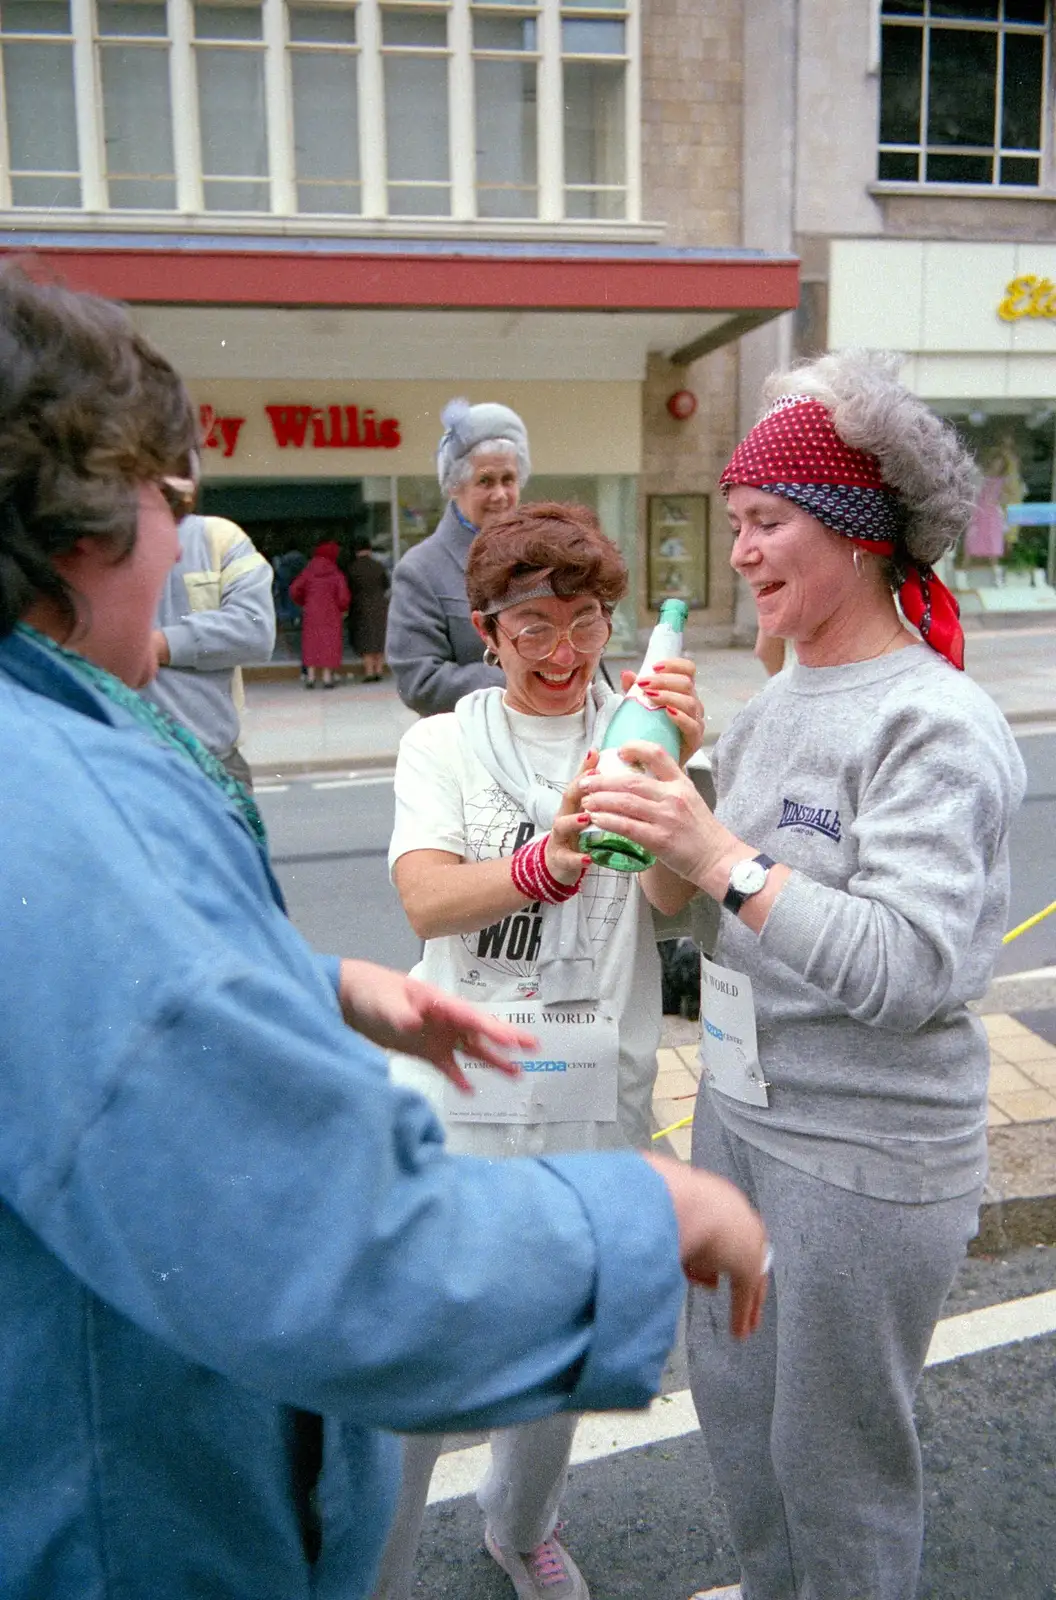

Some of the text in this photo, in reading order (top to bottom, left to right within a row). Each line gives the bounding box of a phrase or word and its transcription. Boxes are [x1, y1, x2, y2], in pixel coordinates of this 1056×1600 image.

[264, 403, 402, 449] Willis
[780, 798, 841, 836] LONSDALE
[477, 915, 541, 961] WOR
[709, 975, 739, 997] WORLD
[506, 1012, 536, 1024] THE
[541, 1012, 596, 1024] WORLD
